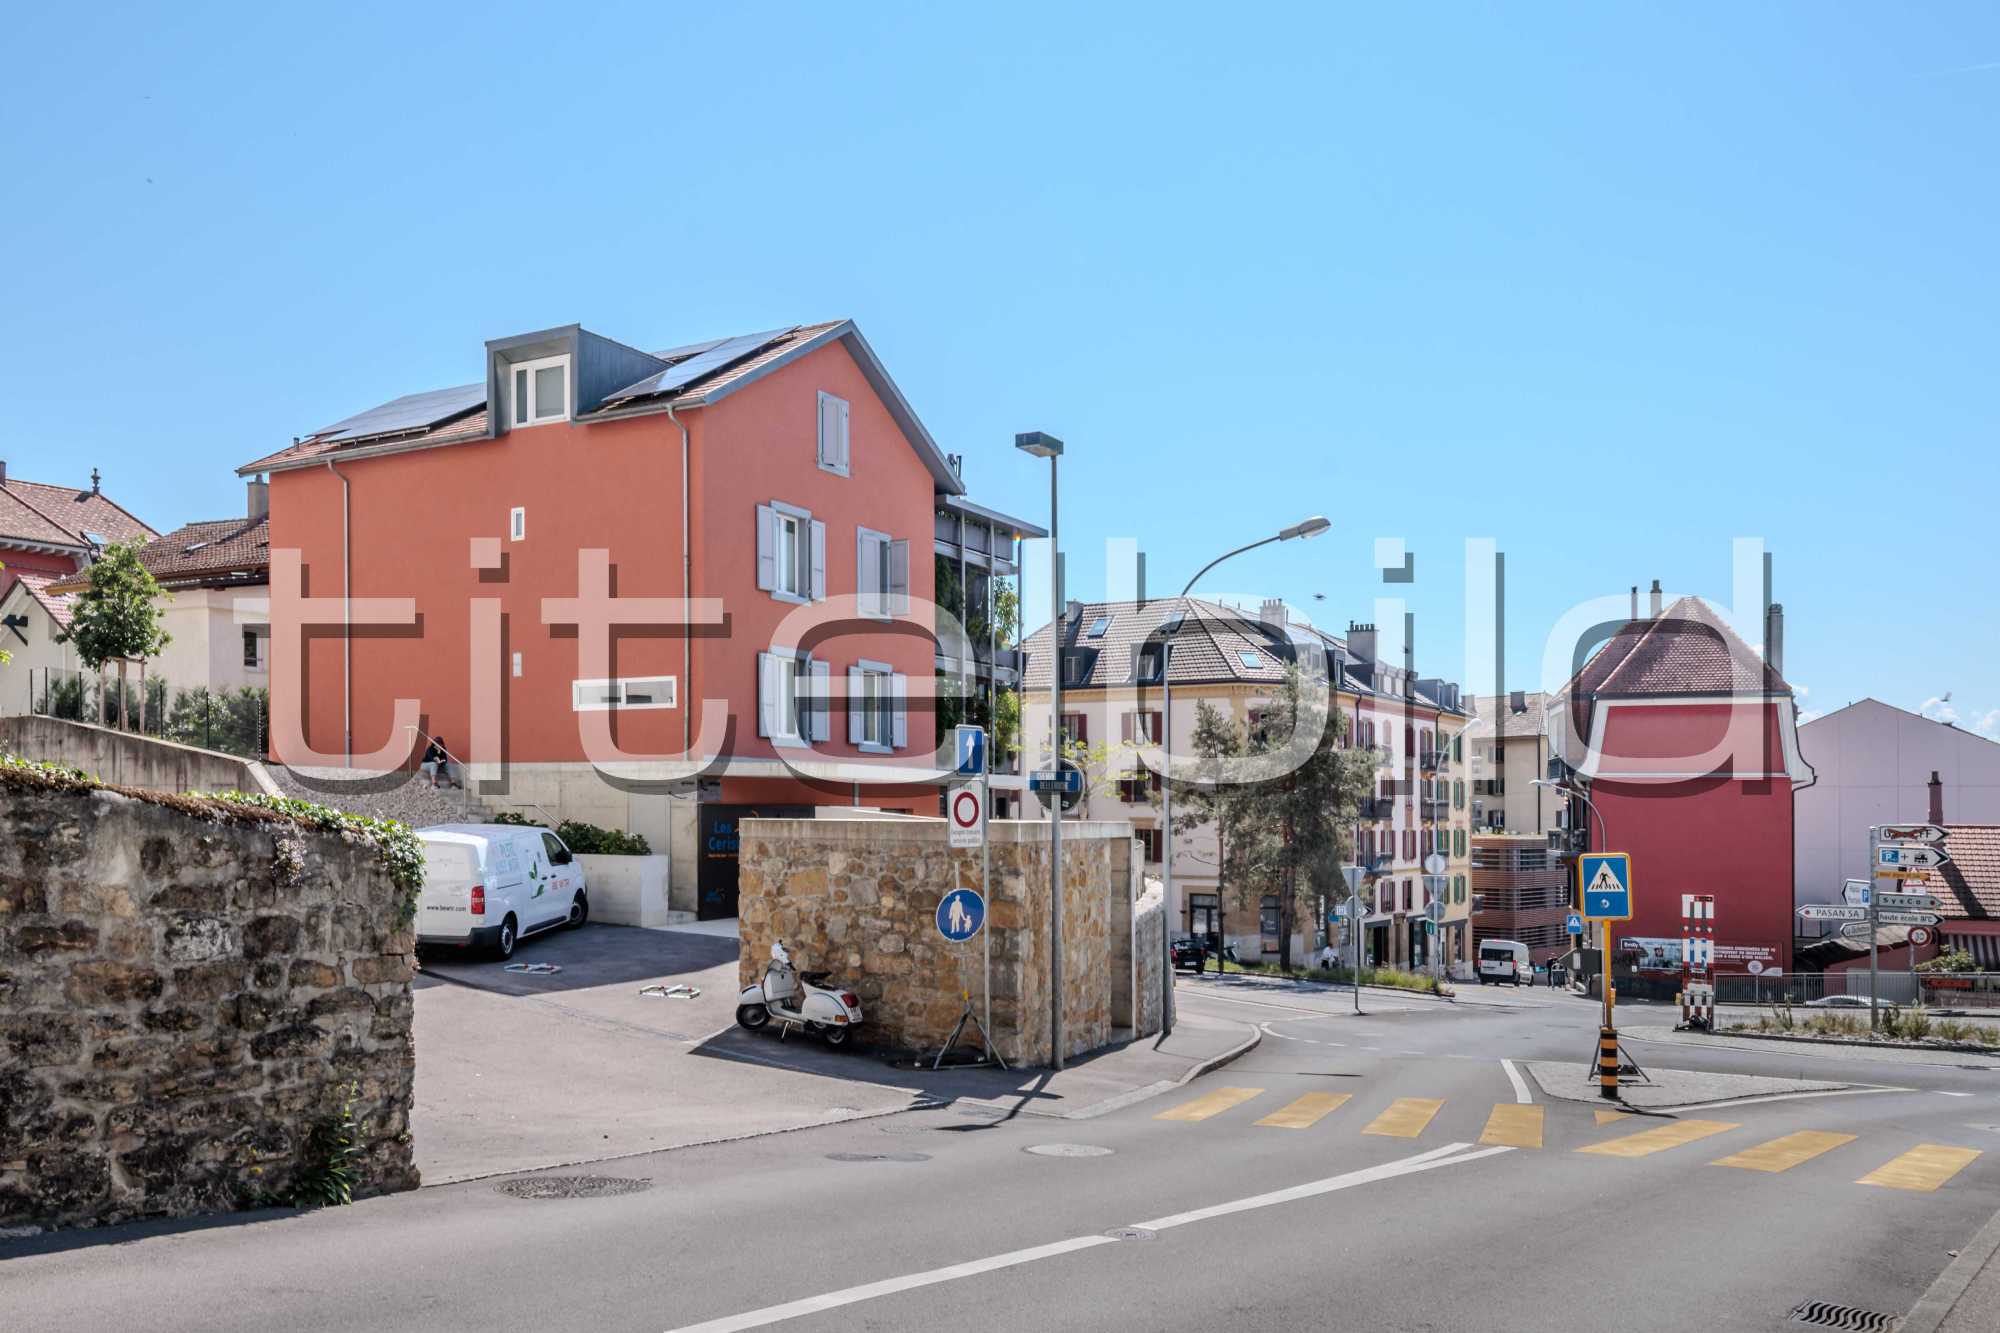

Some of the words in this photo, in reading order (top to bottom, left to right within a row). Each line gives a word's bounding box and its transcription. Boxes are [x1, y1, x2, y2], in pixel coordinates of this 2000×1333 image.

[1816, 908, 1845, 917] PASAN
[1848, 909, 1860, 917] SA
[1880, 913, 1898, 921] haute
[1920, 915, 1933, 923] arc
[1915, 932, 1924, 940] 30
